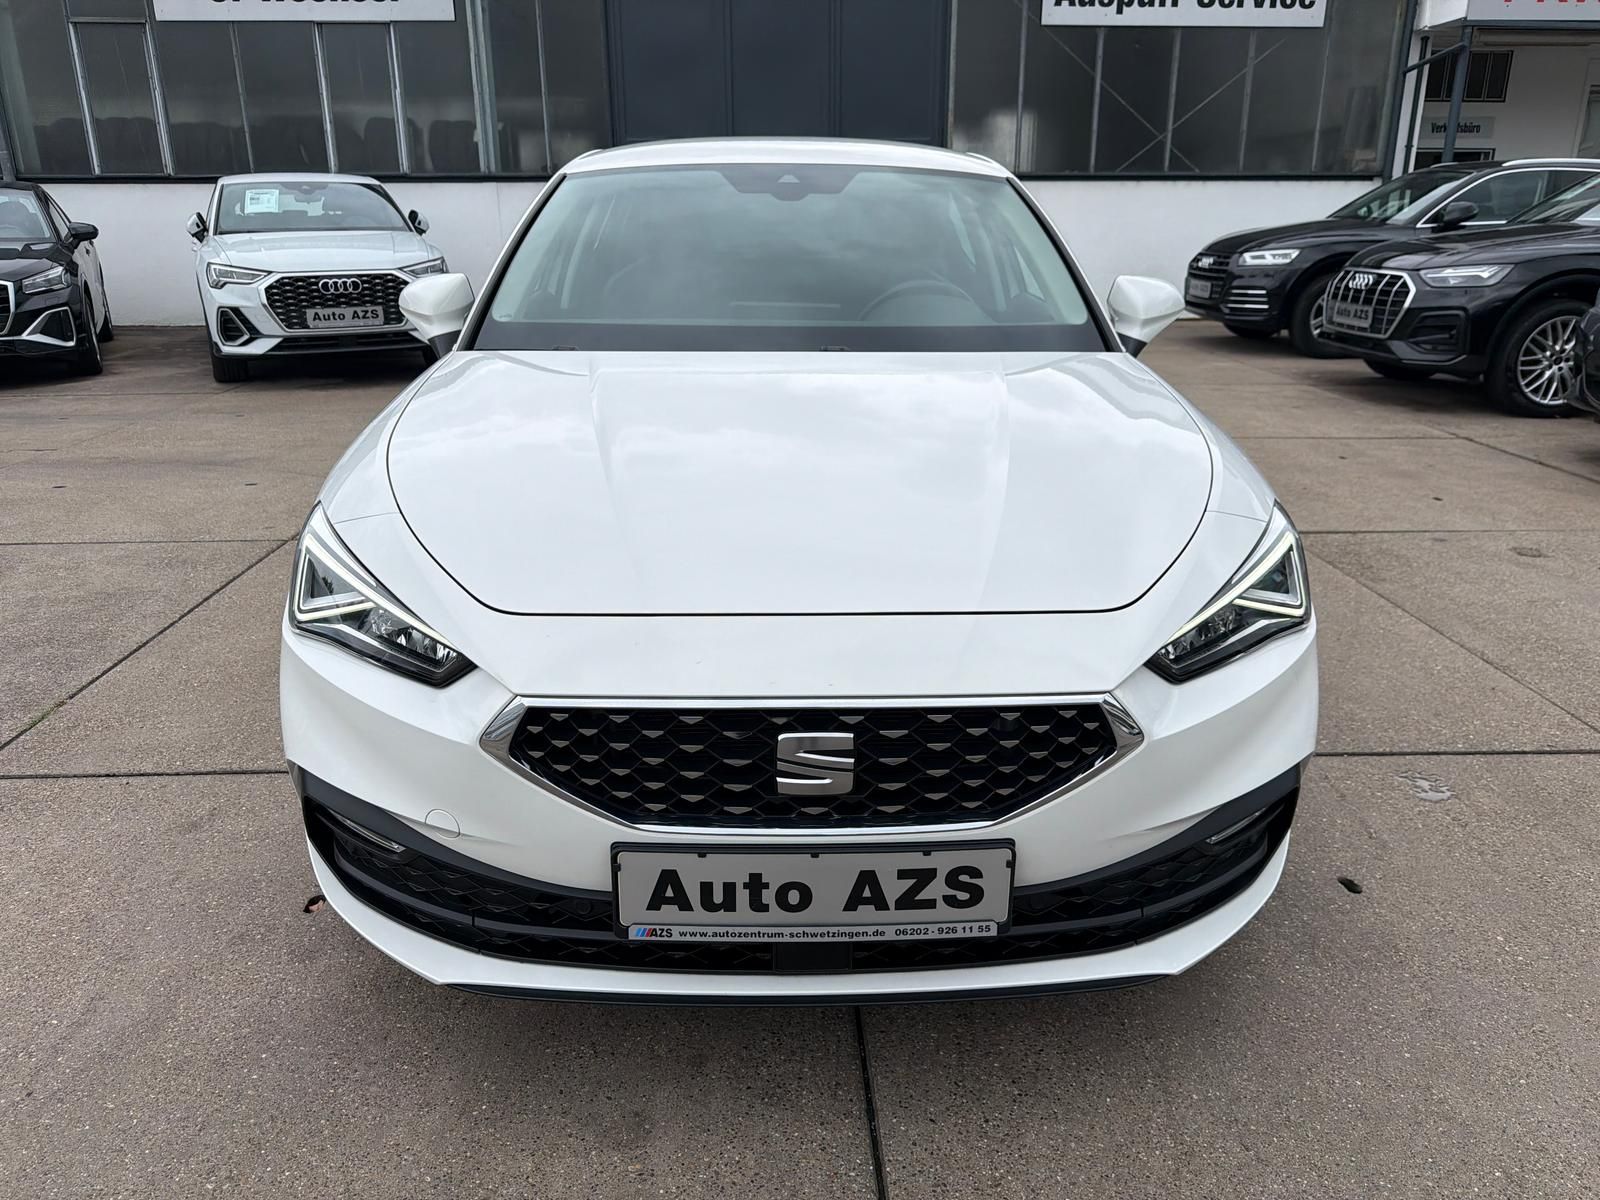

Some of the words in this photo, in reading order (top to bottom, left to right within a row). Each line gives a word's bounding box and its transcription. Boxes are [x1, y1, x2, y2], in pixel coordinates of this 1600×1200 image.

[1431, 121, 1481, 134] Verkfsbüro
[312, 311, 346, 321] Auto
[351, 309, 380, 320] AZS
[645, 868, 814, 914] Auto
[841, 865, 985, 913] AZS
[650, 927, 673, 938] AZS
[678, 928, 886, 940] www.autozentrum-schwetzingen.de
[894, 927, 929, 937] 06202
[937, 926, 958, 935] 926
[961, 925, 974, 934] 11
[977, 924, 991, 933] 55
